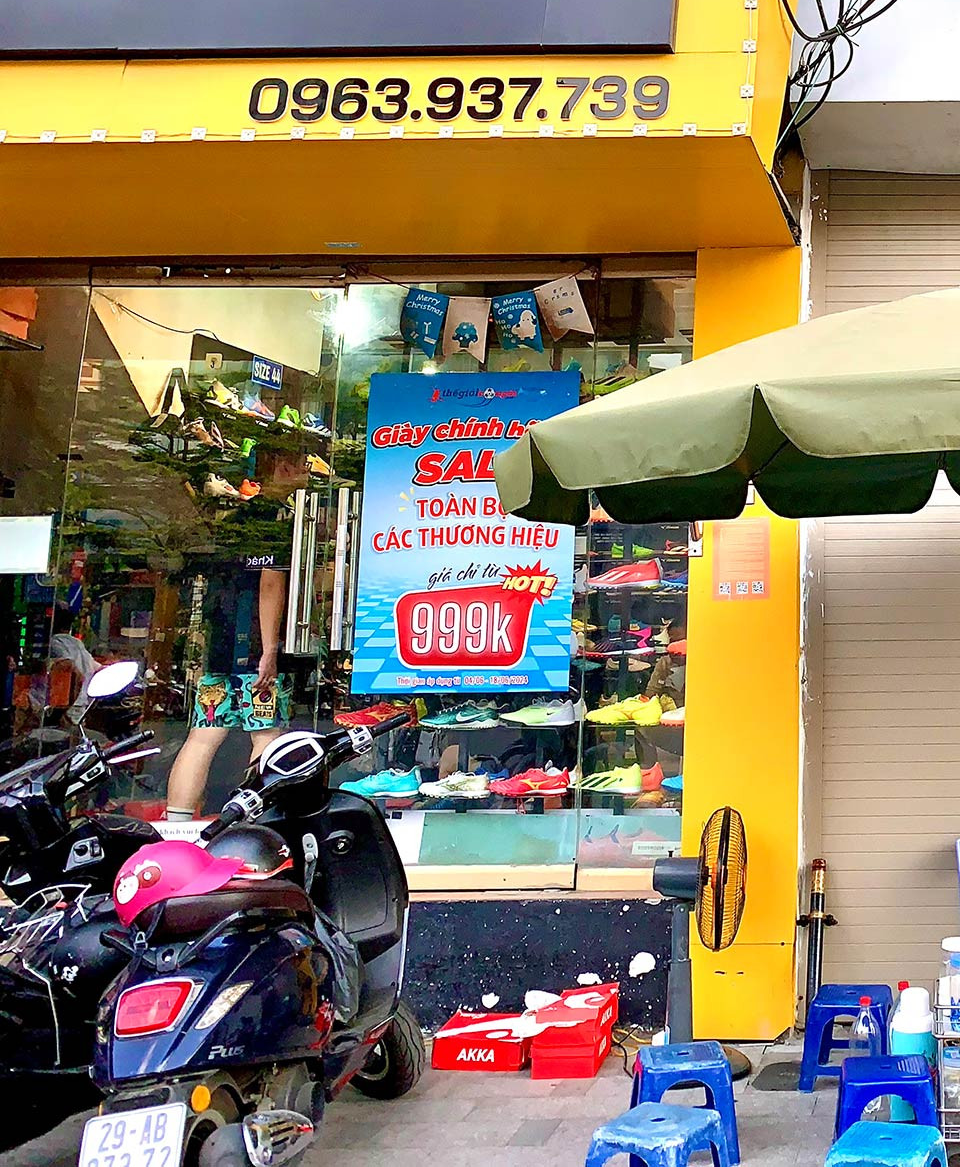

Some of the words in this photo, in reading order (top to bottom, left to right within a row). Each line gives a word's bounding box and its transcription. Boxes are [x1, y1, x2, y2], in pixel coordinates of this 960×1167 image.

[248, 74, 671, 124] 0963.937.739
[405, 300, 445, 316] Christmas
[415, 293, 441, 307] Merry
[497, 303, 531, 316] Christmas
[502, 297, 524, 307] Merry
[254, 361, 270, 382] SIZE
[272, 367, 280, 384] 44
[372, 421, 430, 447] Giày
[434, 416, 503, 441] chính
[414, 449, 496, 485] SAL
[416, 493, 477, 518] TOÀN
[371, 525, 413, 552] CÁC
[418, 524, 505, 547] THƯƠNG
[510, 523, 560, 550] HIỆU
[426, 567, 452, 590] giá
[456, 562, 481, 581] chỉ
[501, 574, 558, 597] HOT!
[410, 600, 514, 654] 999k
[455, 1047, 496, 1063] AKKA
[97, 1111, 169, 1154] 29-AB
